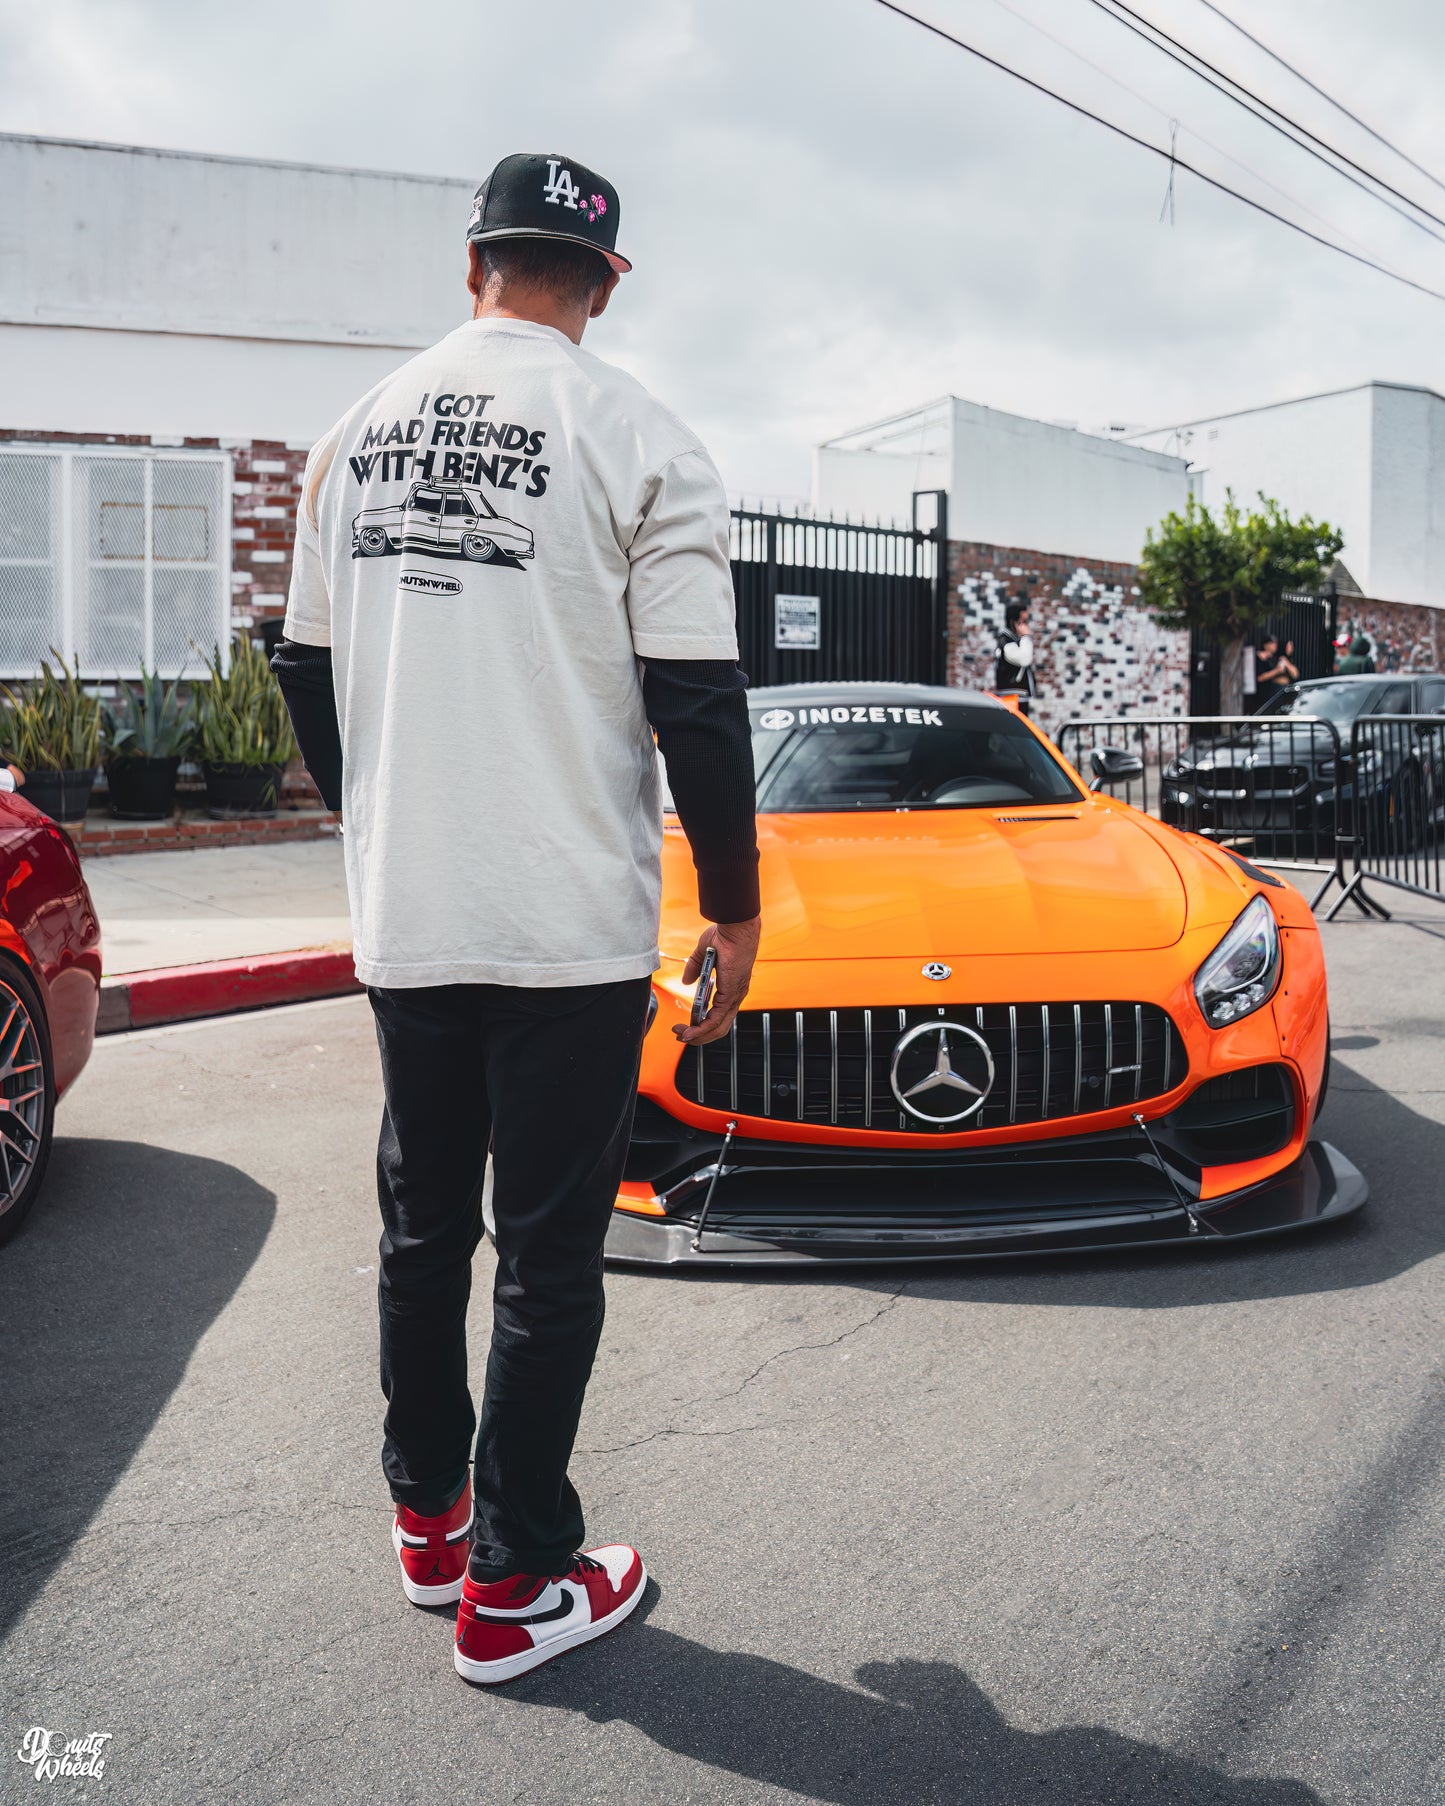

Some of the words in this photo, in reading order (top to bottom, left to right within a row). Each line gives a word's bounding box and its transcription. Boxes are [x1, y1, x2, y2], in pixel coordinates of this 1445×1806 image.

[543, 159, 580, 210] LA
[418, 392, 430, 415] I
[433, 394, 495, 417] GOT
[361, 419, 425, 450] MAD
[431, 420, 546, 456] FRIENDS
[348, 450, 436, 486] WITH
[442, 451, 550, 497] BENZ'S
[399, 576, 460, 592] NUTSNWHEELS
[798, 707, 943, 726] INOZETEK
